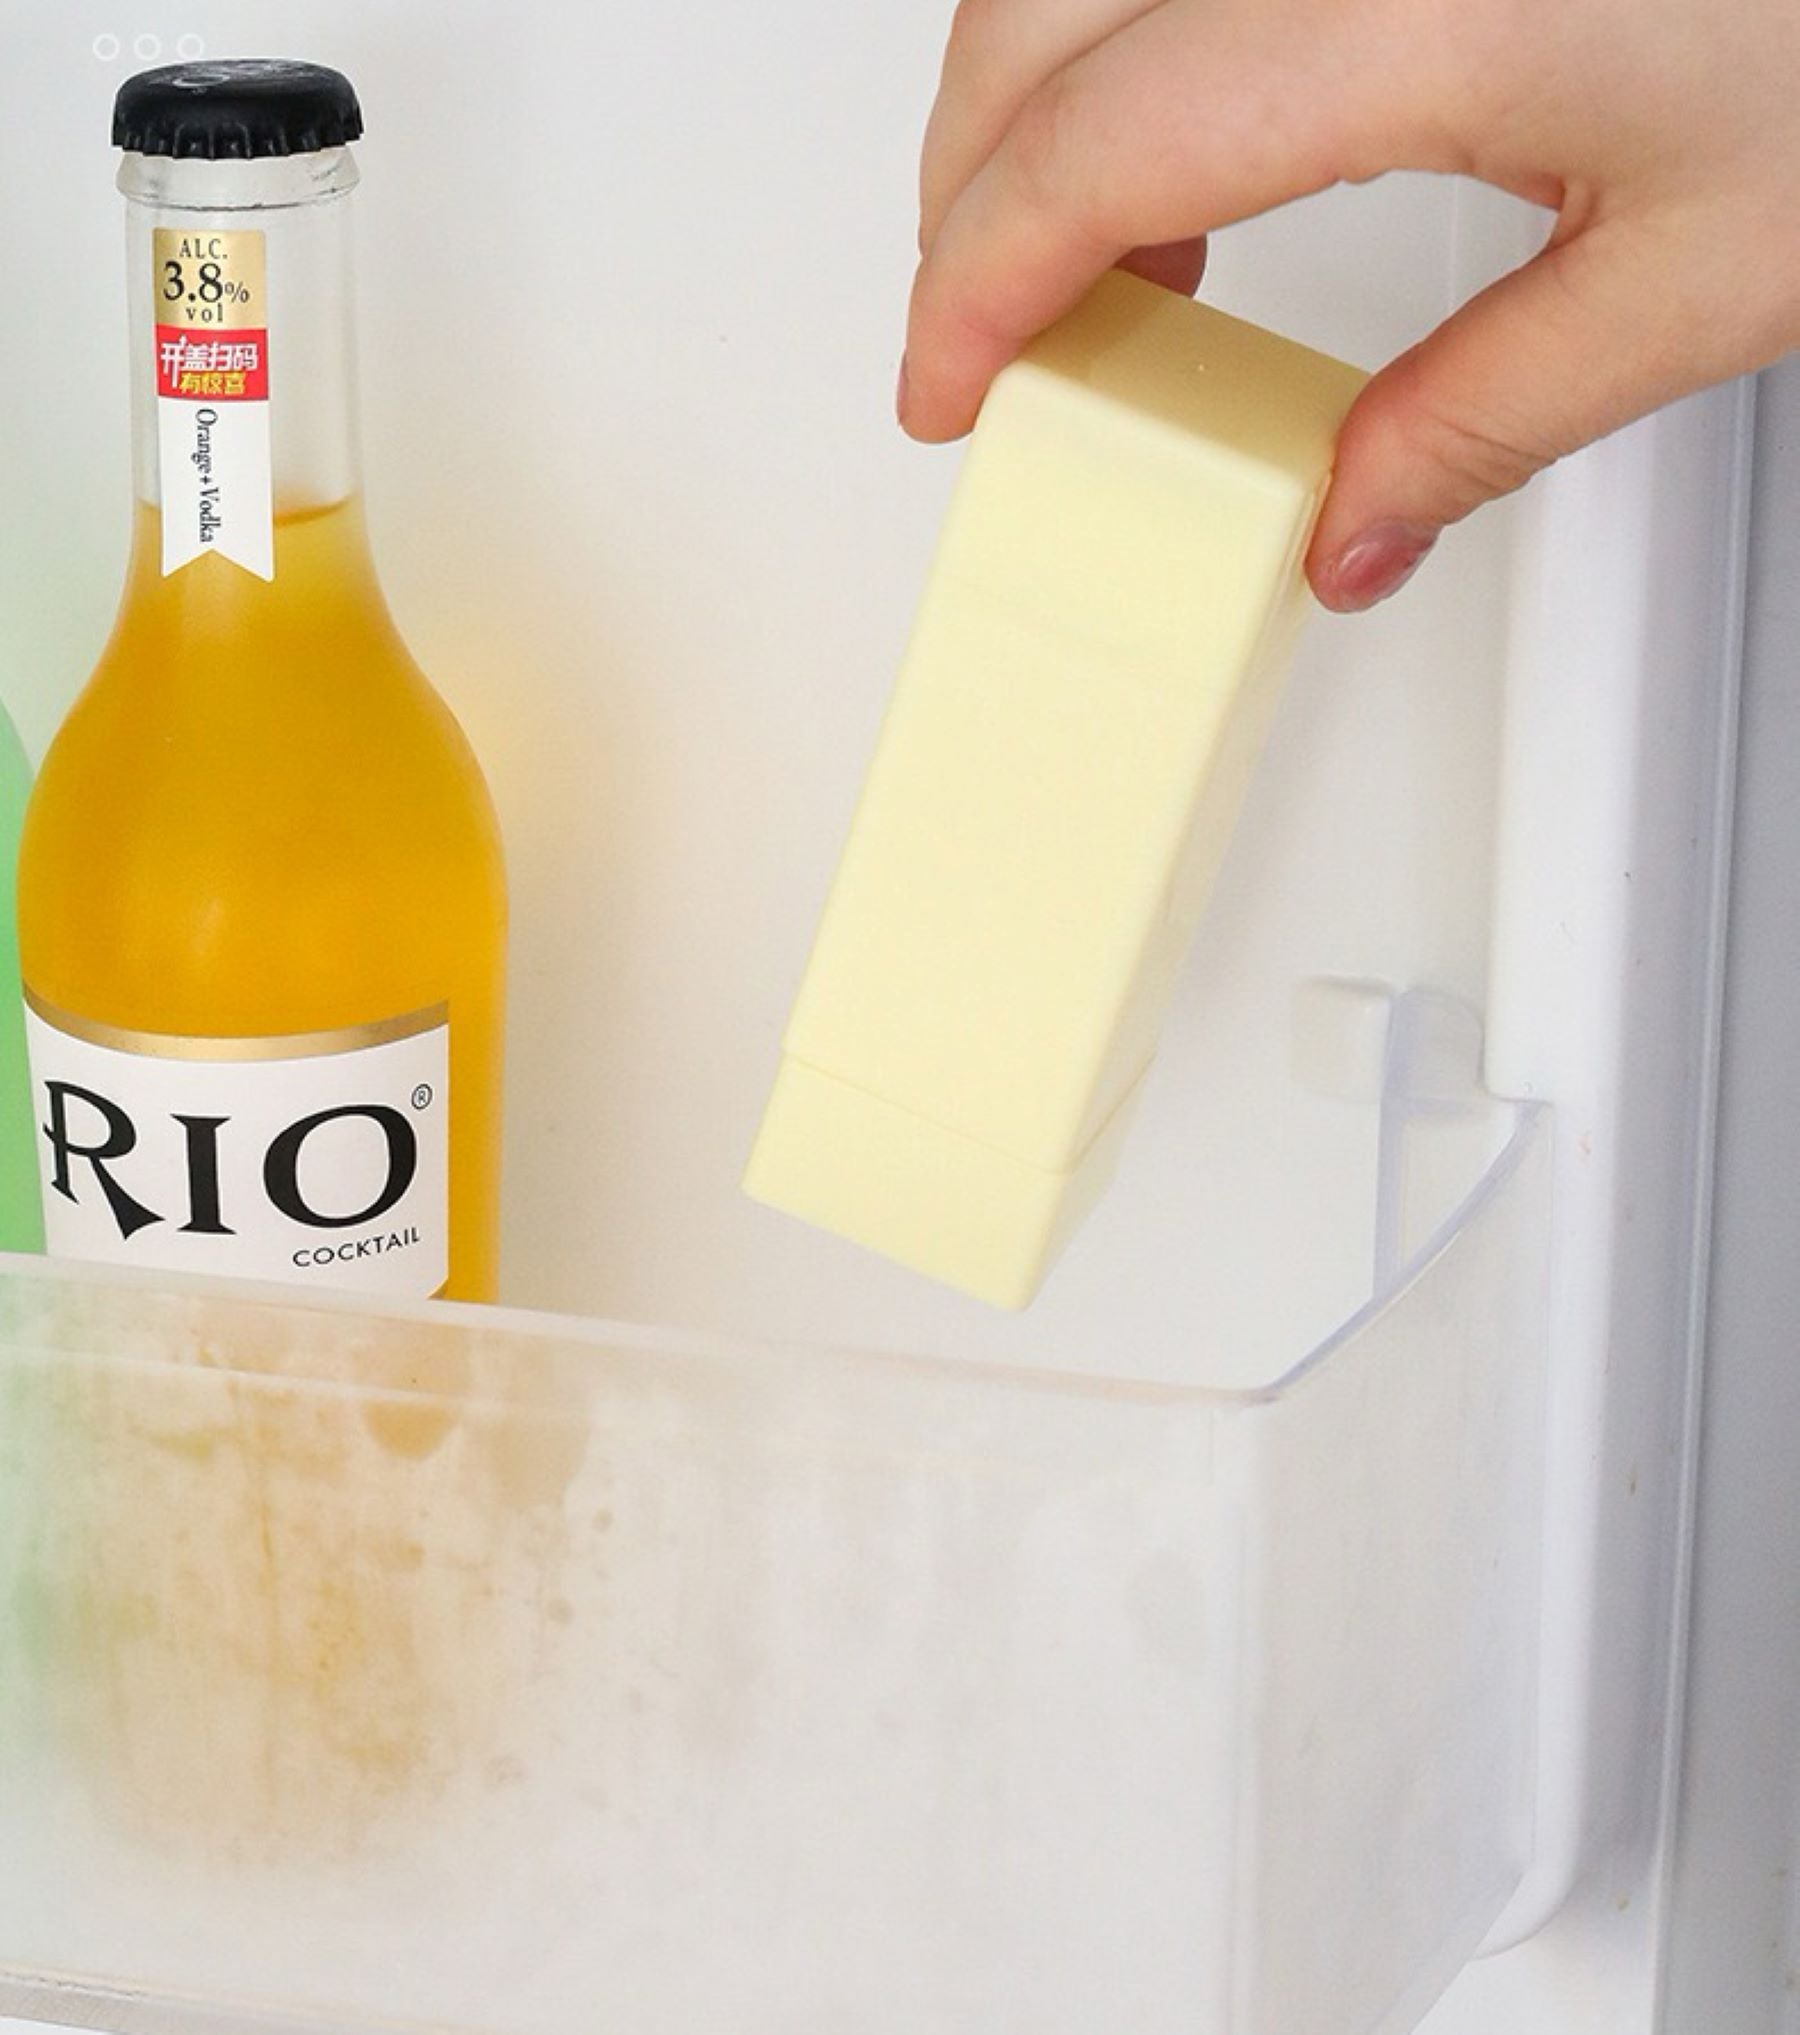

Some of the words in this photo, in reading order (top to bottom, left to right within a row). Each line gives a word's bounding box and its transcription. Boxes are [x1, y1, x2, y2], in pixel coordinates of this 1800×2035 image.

[180, 238, 228, 259] ALC.
[163, 261, 251, 303] 3.8%
[186, 302, 223, 322] vol
[161, 335, 258, 388] 开盖扫码
[42, 1081, 418, 1241] RIO
[292, 1226, 421, 1267] COCKTAIL
